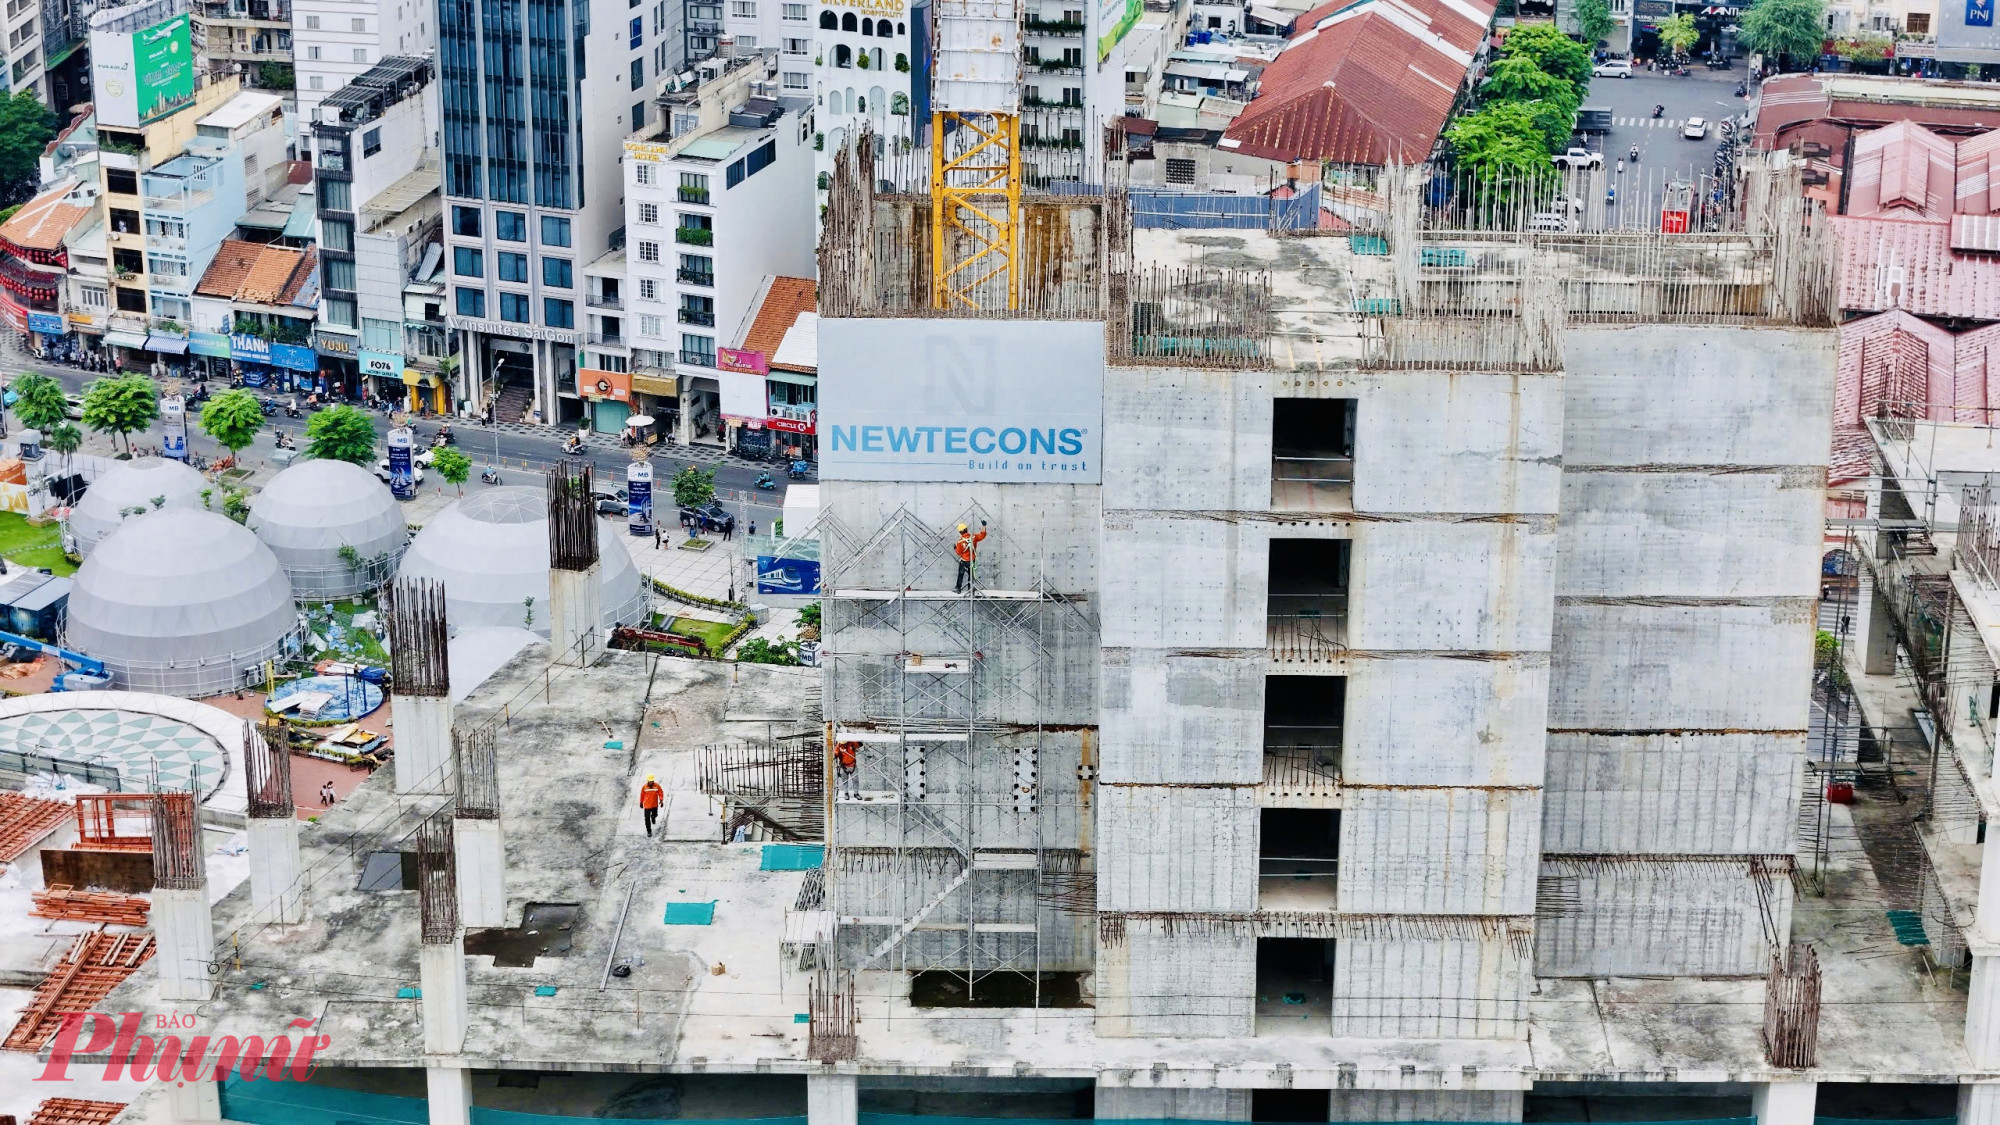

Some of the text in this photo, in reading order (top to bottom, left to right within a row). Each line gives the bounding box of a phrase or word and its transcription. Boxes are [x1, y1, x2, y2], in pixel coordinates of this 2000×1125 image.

[861, 9, 904, 18] HOSPITALITY
[1970, 9, 1989, 22] PNJ
[231, 335, 269, 353] THANH
[321, 339, 349, 352] YUJU
[776, 421, 797, 429] CIRCLE
[969, 459, 1008, 470] Build
[1042, 460, 1088, 471] trust
[802, 653, 813, 662] MB
